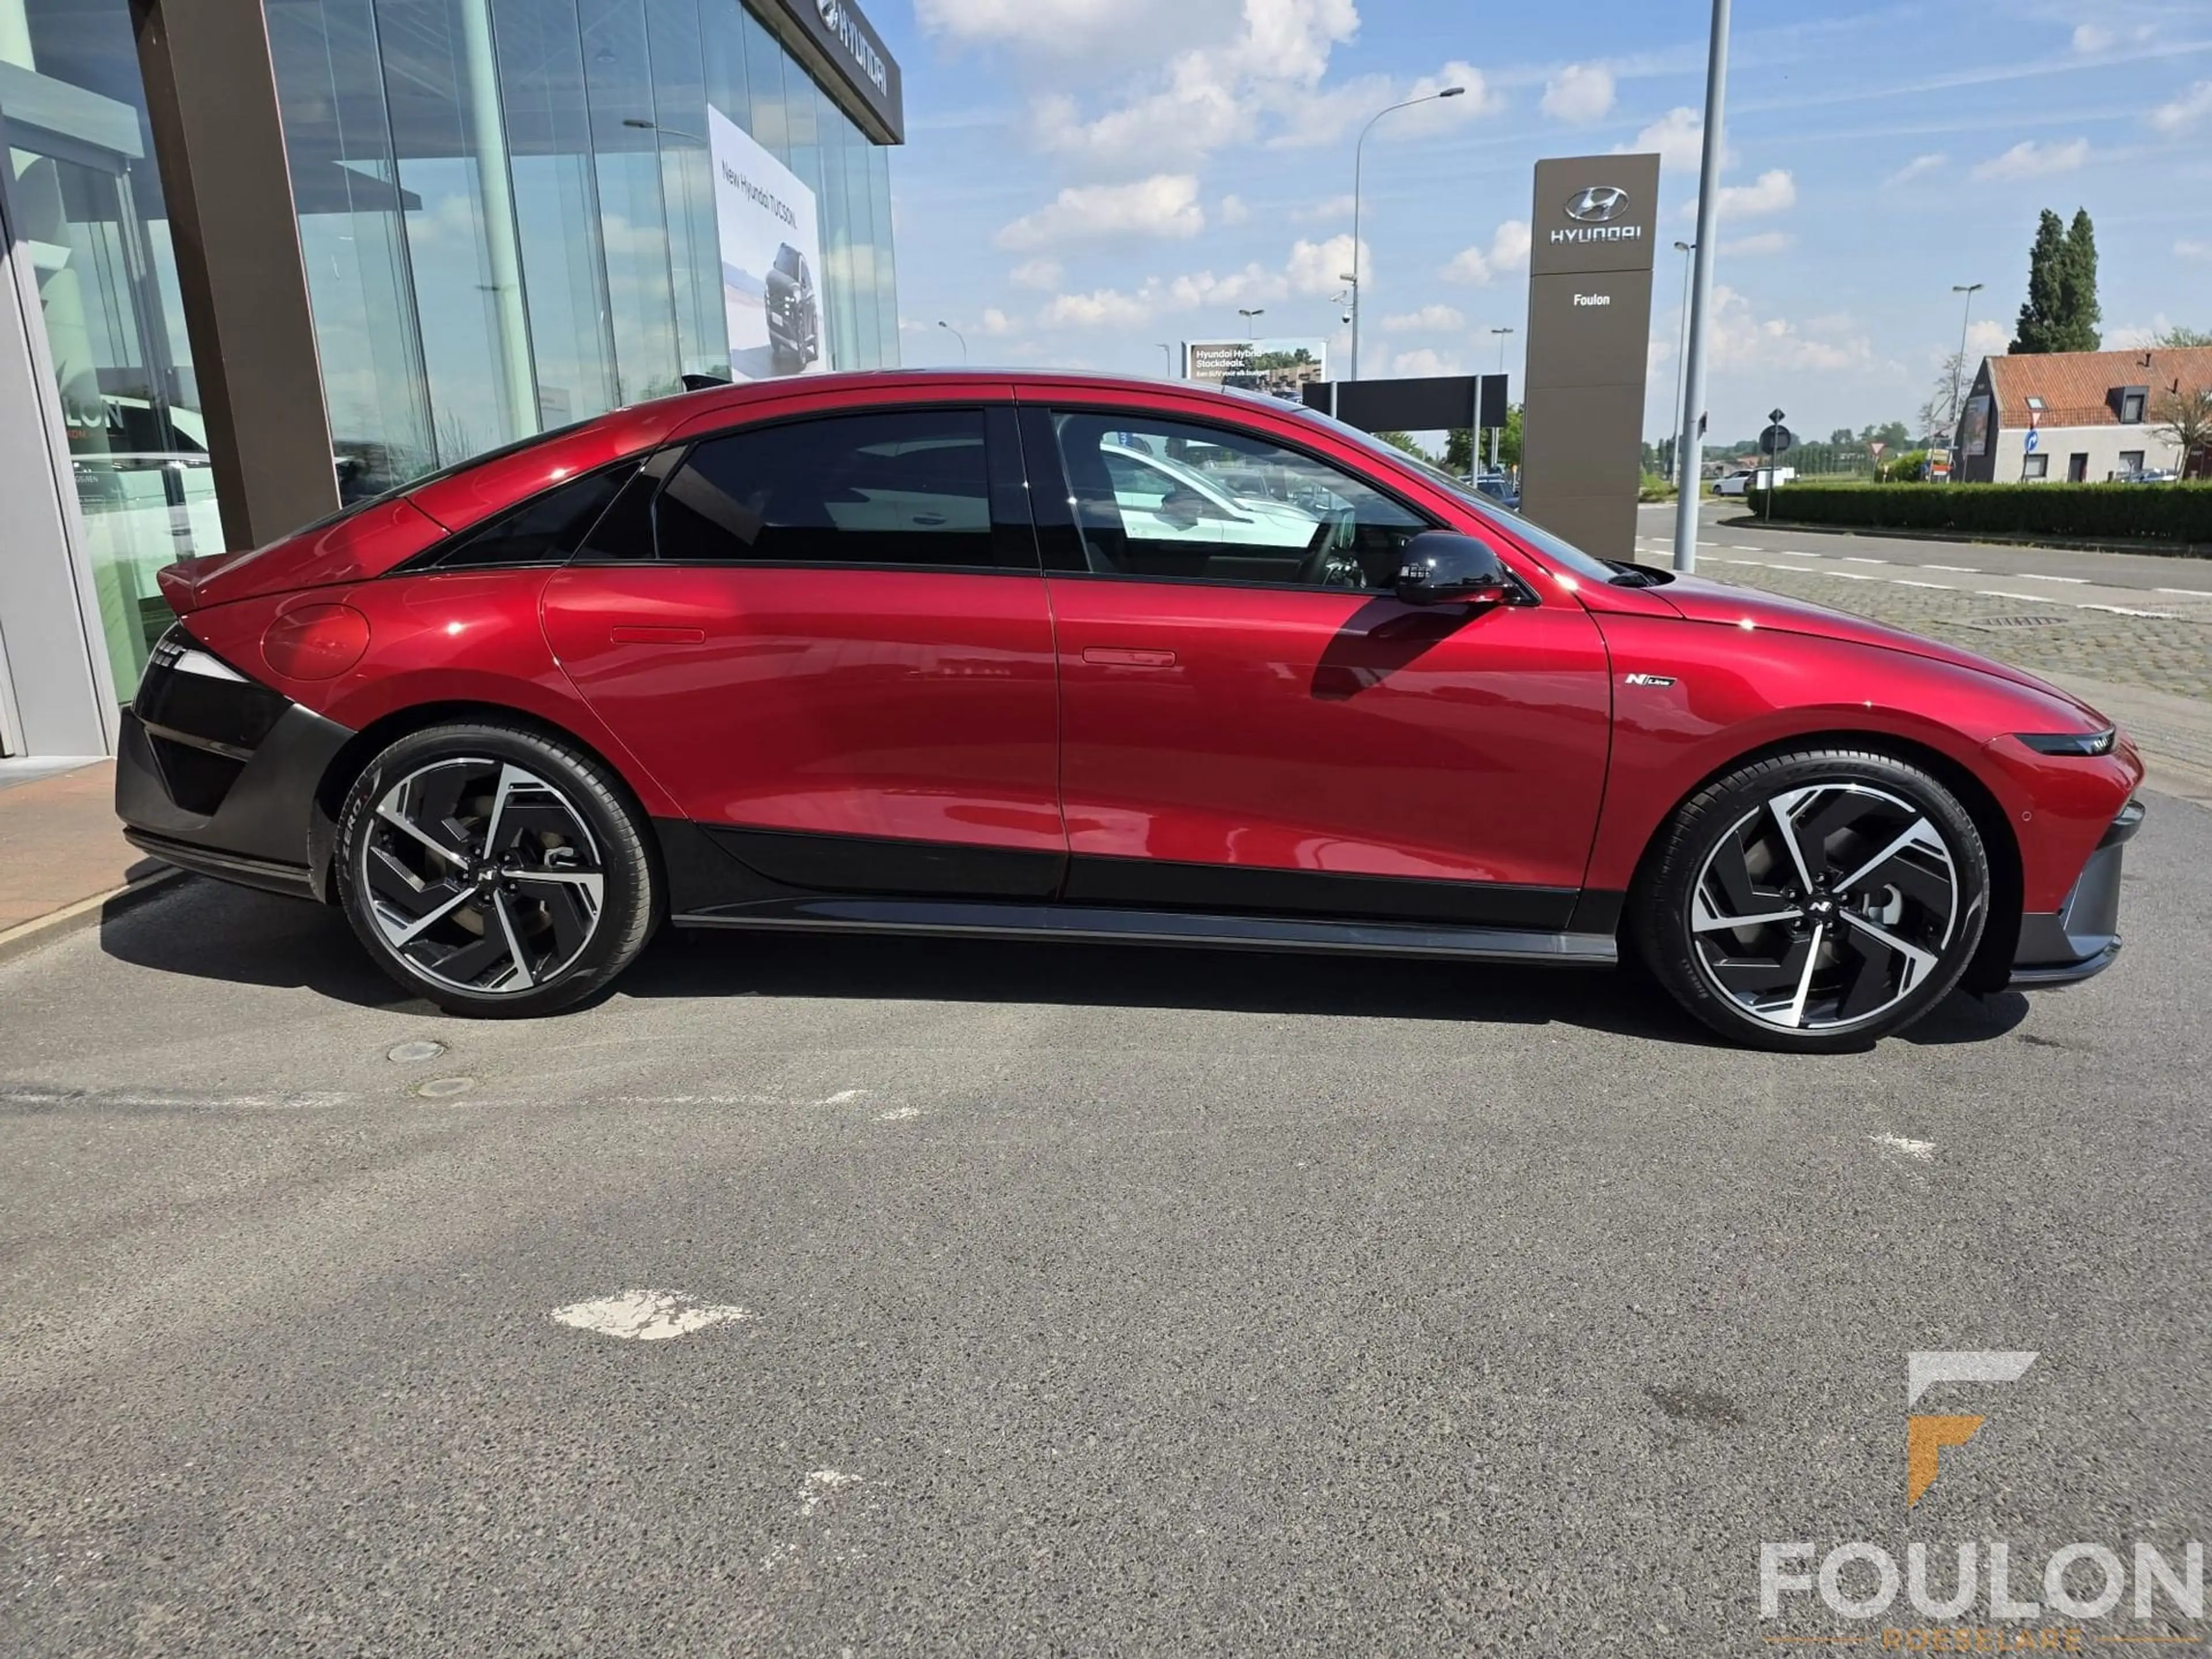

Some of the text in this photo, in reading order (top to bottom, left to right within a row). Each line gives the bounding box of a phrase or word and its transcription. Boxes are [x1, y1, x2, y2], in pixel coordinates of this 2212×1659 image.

[838, 2, 887, 97] HYUNDAI
[722, 158, 740, 189] New
[740, 172, 770, 210] Hyundai
[1550, 226, 1641, 244] HYUNDAI
[1574, 294, 1611, 306] Foulon
[1196, 350, 1232, 359] Hyundai
[342, 797, 362, 861] ZERO
